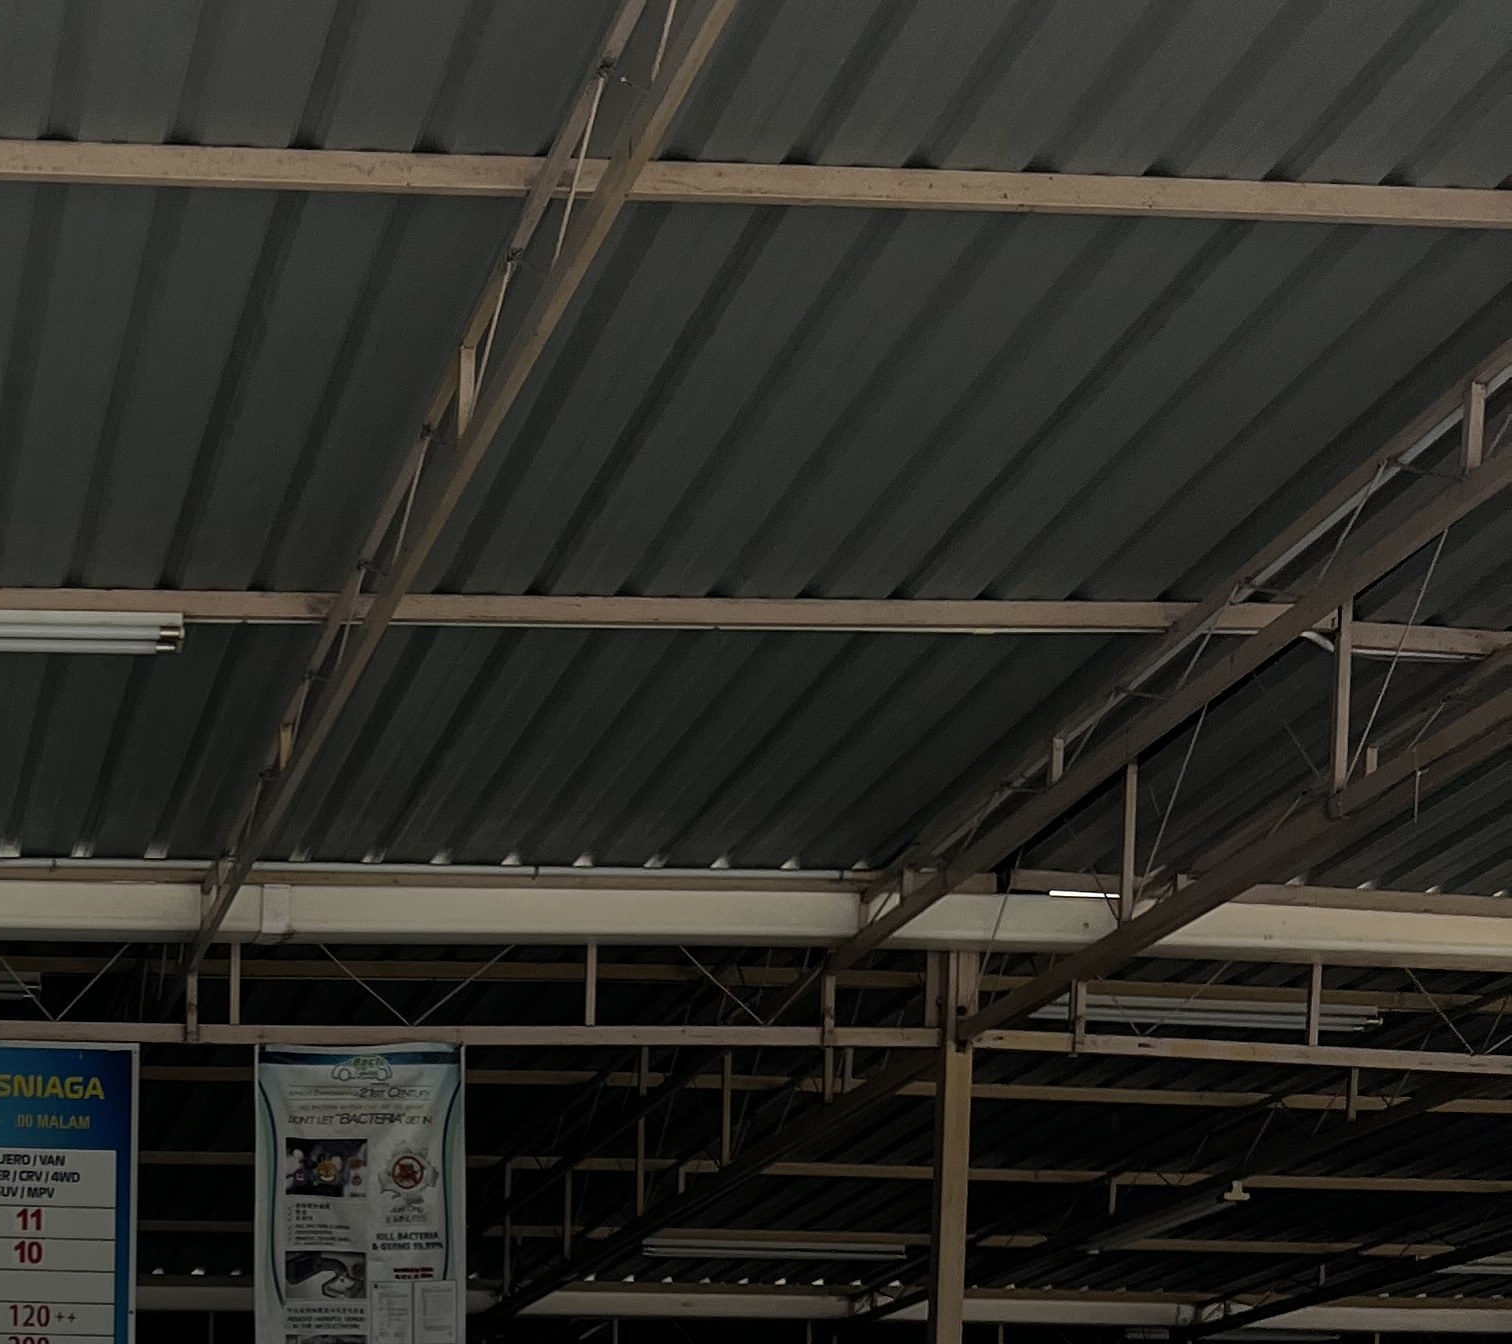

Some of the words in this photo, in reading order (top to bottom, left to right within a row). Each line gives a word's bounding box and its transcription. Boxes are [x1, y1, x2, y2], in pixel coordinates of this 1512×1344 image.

[37, 1114, 91, 1130] MALAM
[39, 1154, 66, 1167] VAN
[19, 1170, 42, 1183] CRV
[51, 1171, 81, 1184] 4WD
[27, 1187, 56, 1199] MPV
[16, 1208, 43, 1231] 11
[397, 1232, 439, 1241] BACTERIA
[14, 1240, 43, 1264] 10
[9, 1304, 51, 1328] 120
